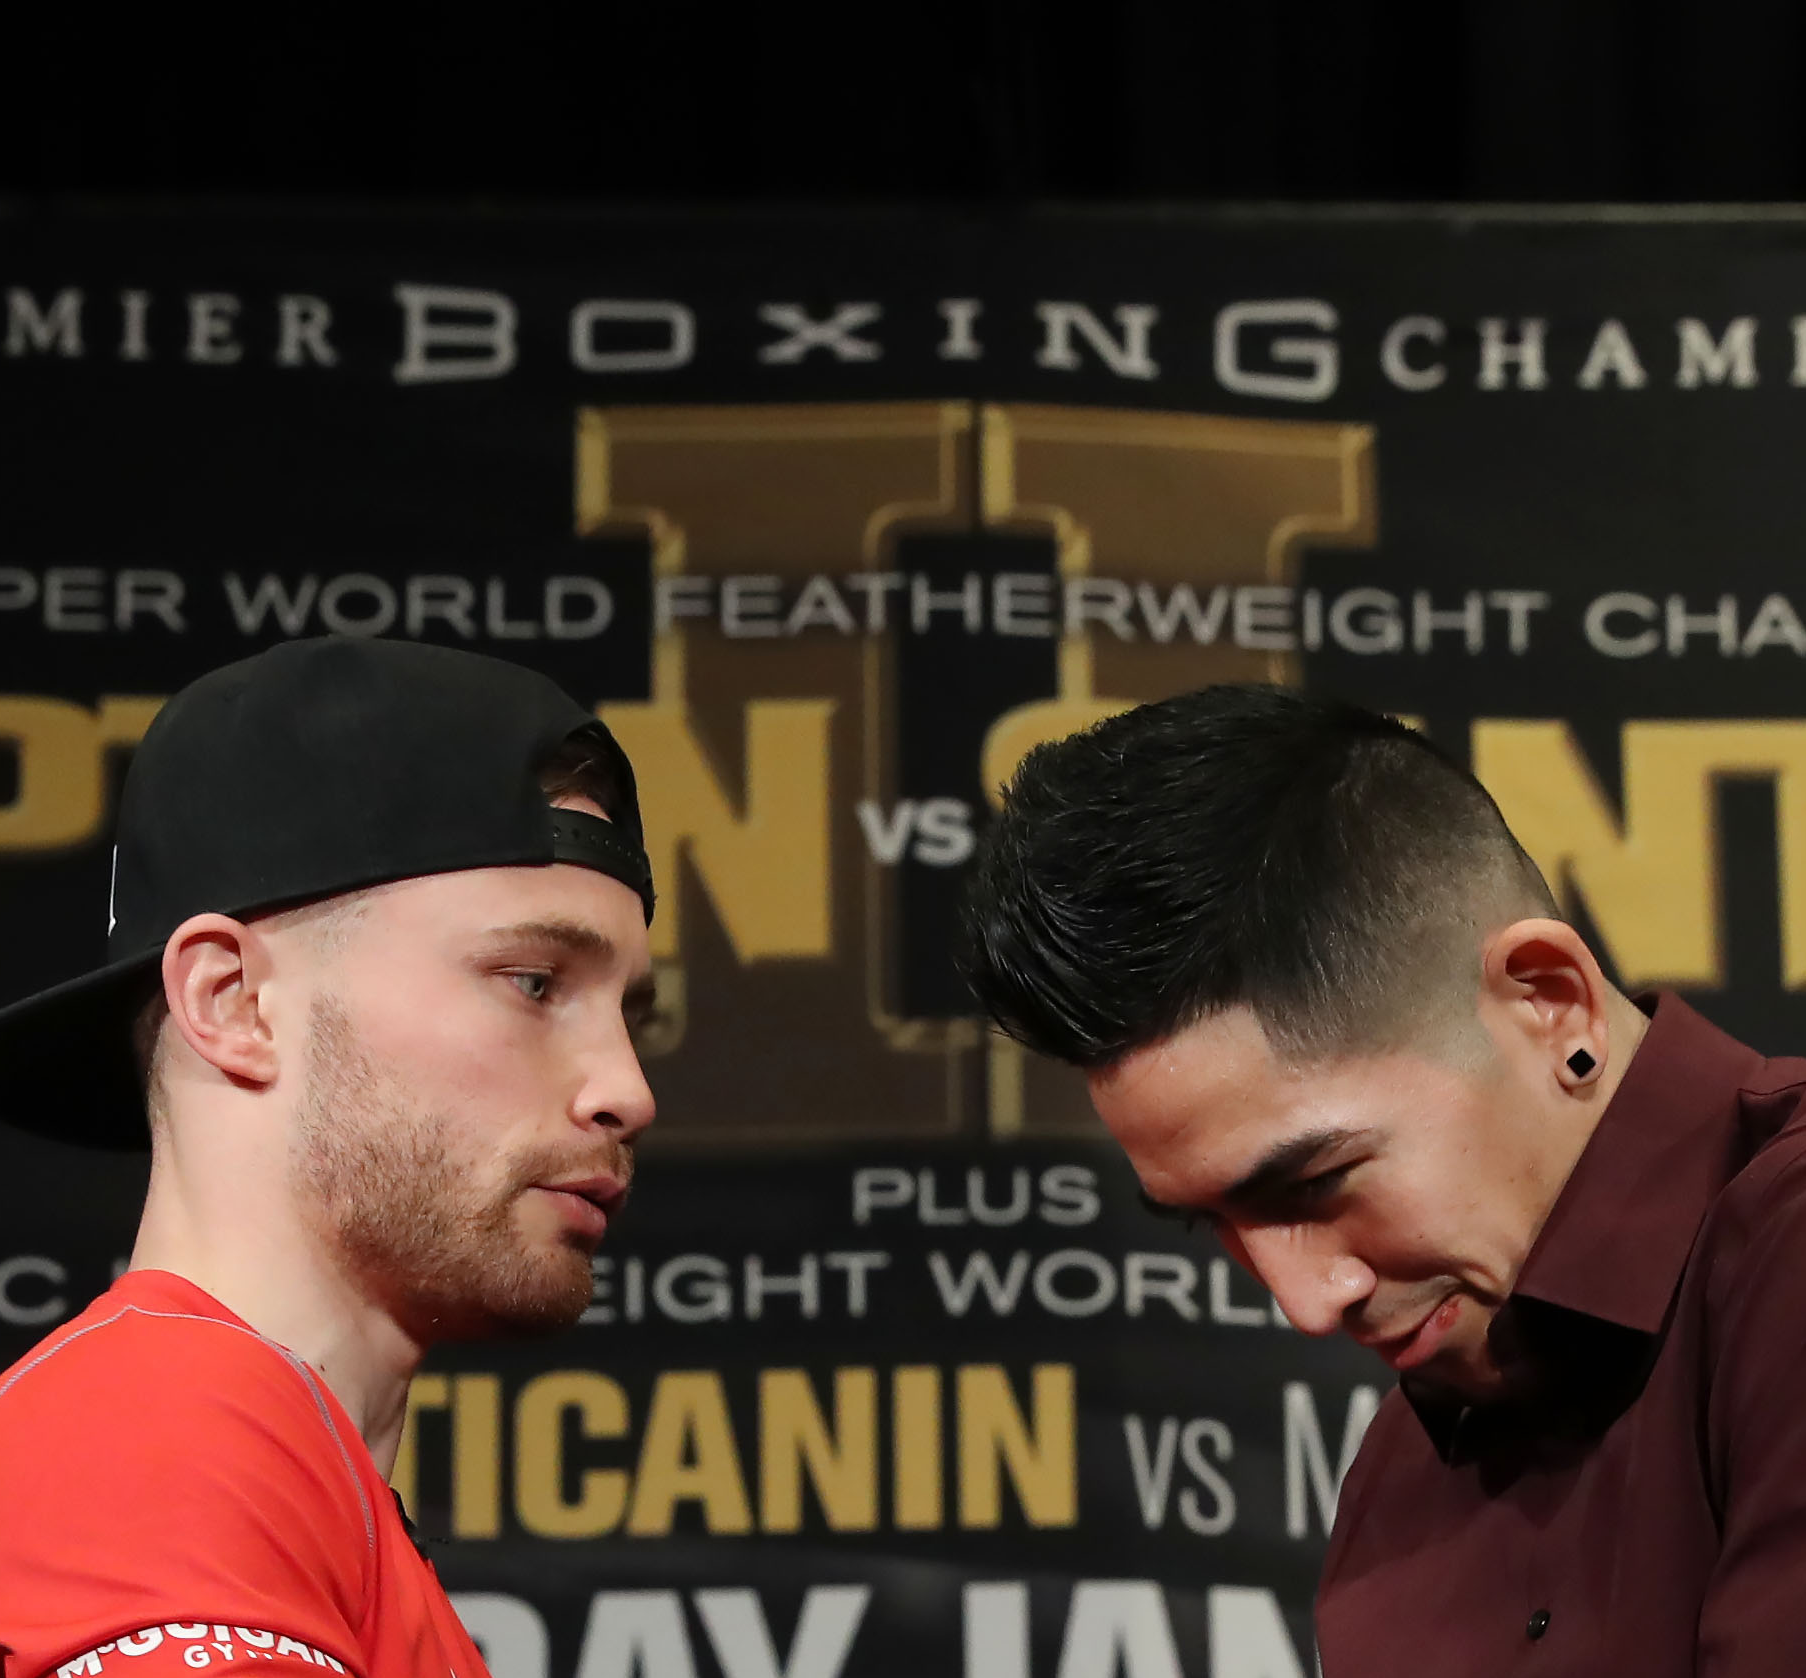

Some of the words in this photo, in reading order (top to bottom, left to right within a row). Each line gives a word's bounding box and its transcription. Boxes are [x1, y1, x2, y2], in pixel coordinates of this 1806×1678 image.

[395, 282, 1340, 400] BOXING
[223, 572, 615, 640] WORLD
[653, 572, 1549, 656] FEATHERWEIGHT
[857, 800, 975, 866] VS
[853, 1166, 1100, 1226] PLUS
[929, 1250, 1290, 1330] WORL
[183, 1641, 274, 1669] GY
